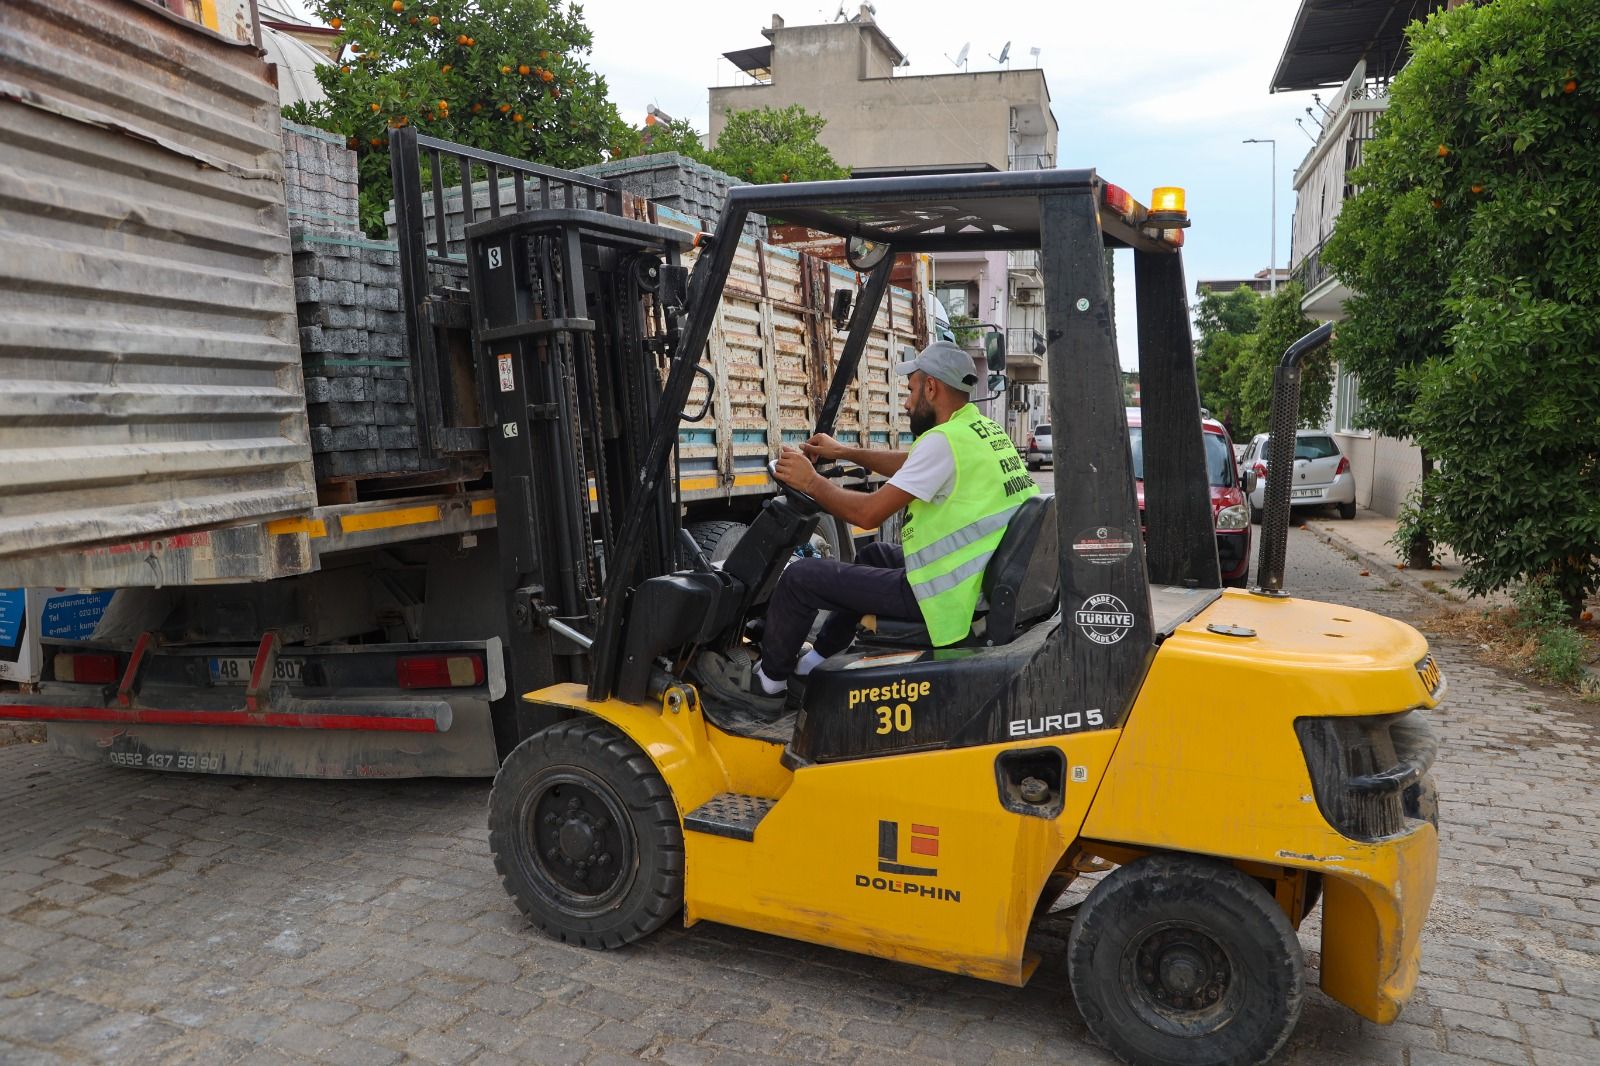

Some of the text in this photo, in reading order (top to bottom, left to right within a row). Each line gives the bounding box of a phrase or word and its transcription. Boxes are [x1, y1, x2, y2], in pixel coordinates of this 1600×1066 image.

[1090, 595, 1111, 606] MADE
[48, 613, 59, 622] Tel
[1079, 613, 1131, 625] TÜRKİYE
[49, 625, 71, 635] e-mail
[1090, 631, 1120, 643] MADE IN
[221, 660, 239, 678] 48
[849, 679, 931, 709] prestige
[875, 703, 912, 735] 30
[1009, 709, 1104, 736] EURO 5
[110, 752, 219, 770] 0552 437 59 90
[855, 874, 961, 903] DOLPHIN
